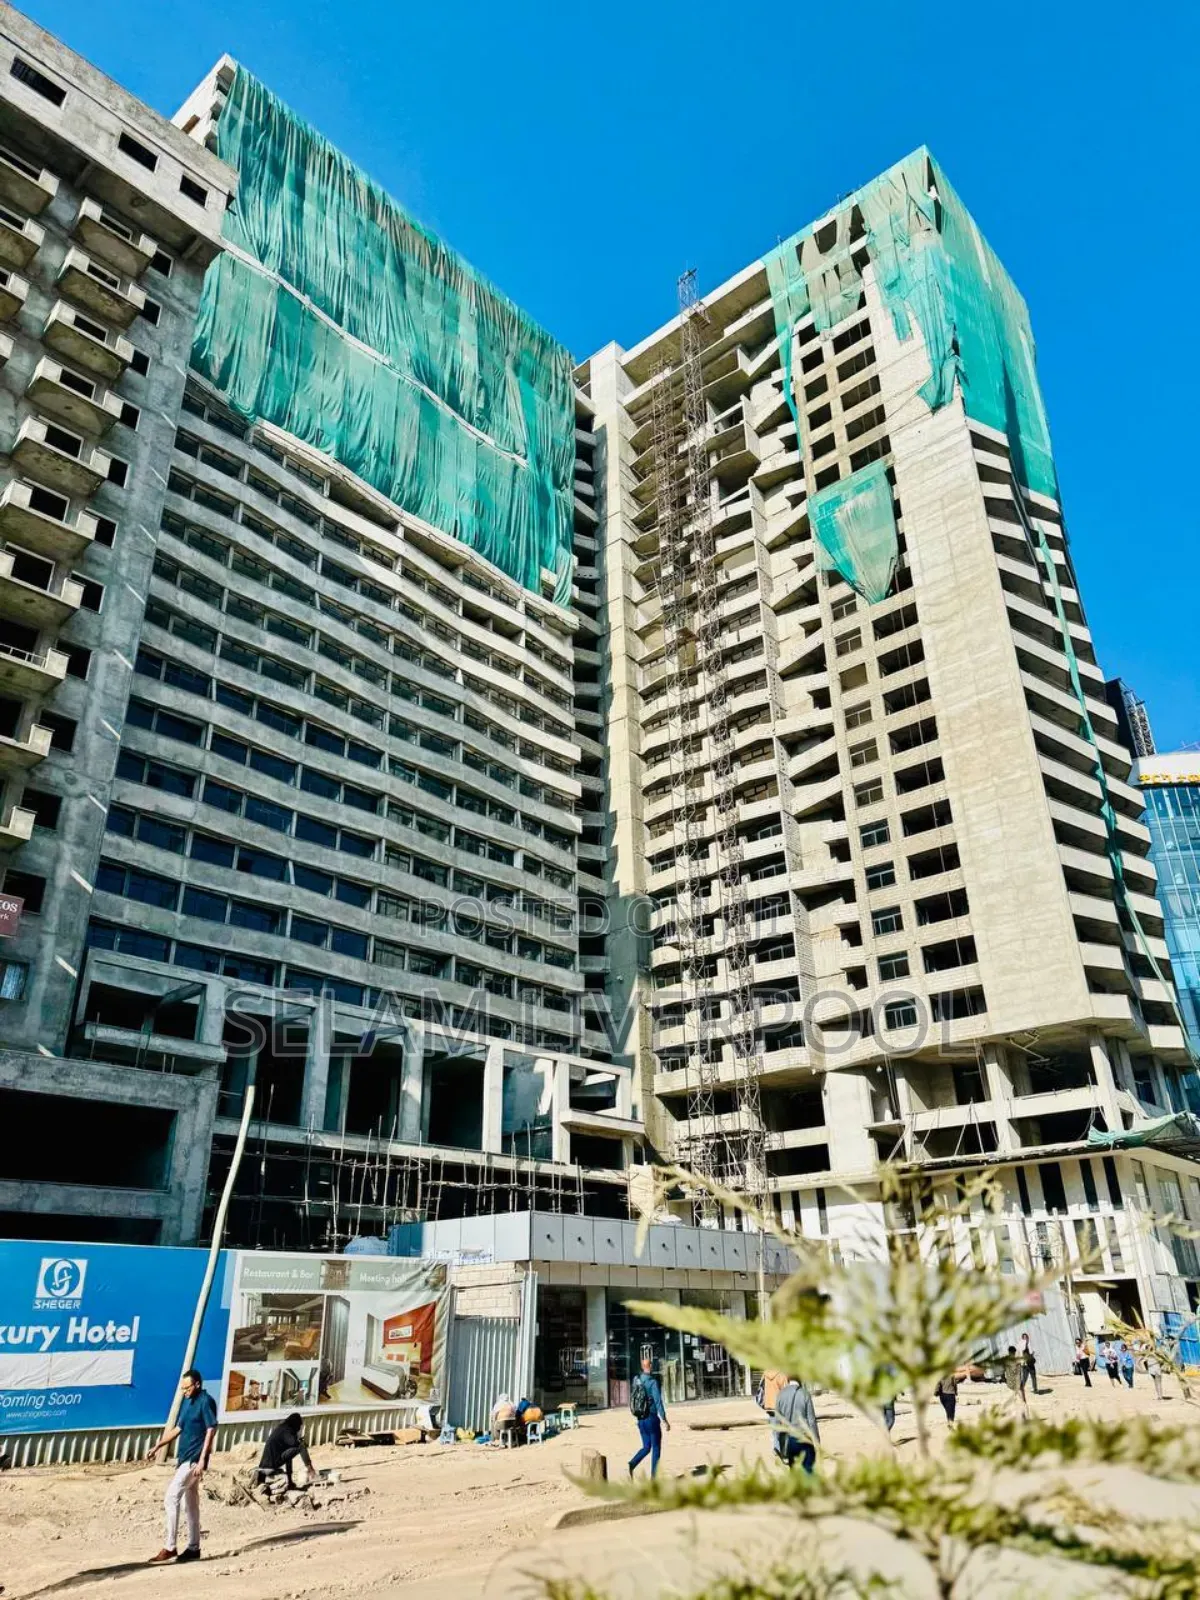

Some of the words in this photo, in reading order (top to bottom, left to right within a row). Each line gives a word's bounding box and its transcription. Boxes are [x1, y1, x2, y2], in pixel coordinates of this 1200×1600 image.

[243, 1267, 289, 1279] Restaurant
[359, 1272, 391, 1285] Meeting
[33, 1299, 81, 1310] SHEGER
[66, 1316, 140, 1343] Hotel
[48, 1392, 82, 1405] Soon
